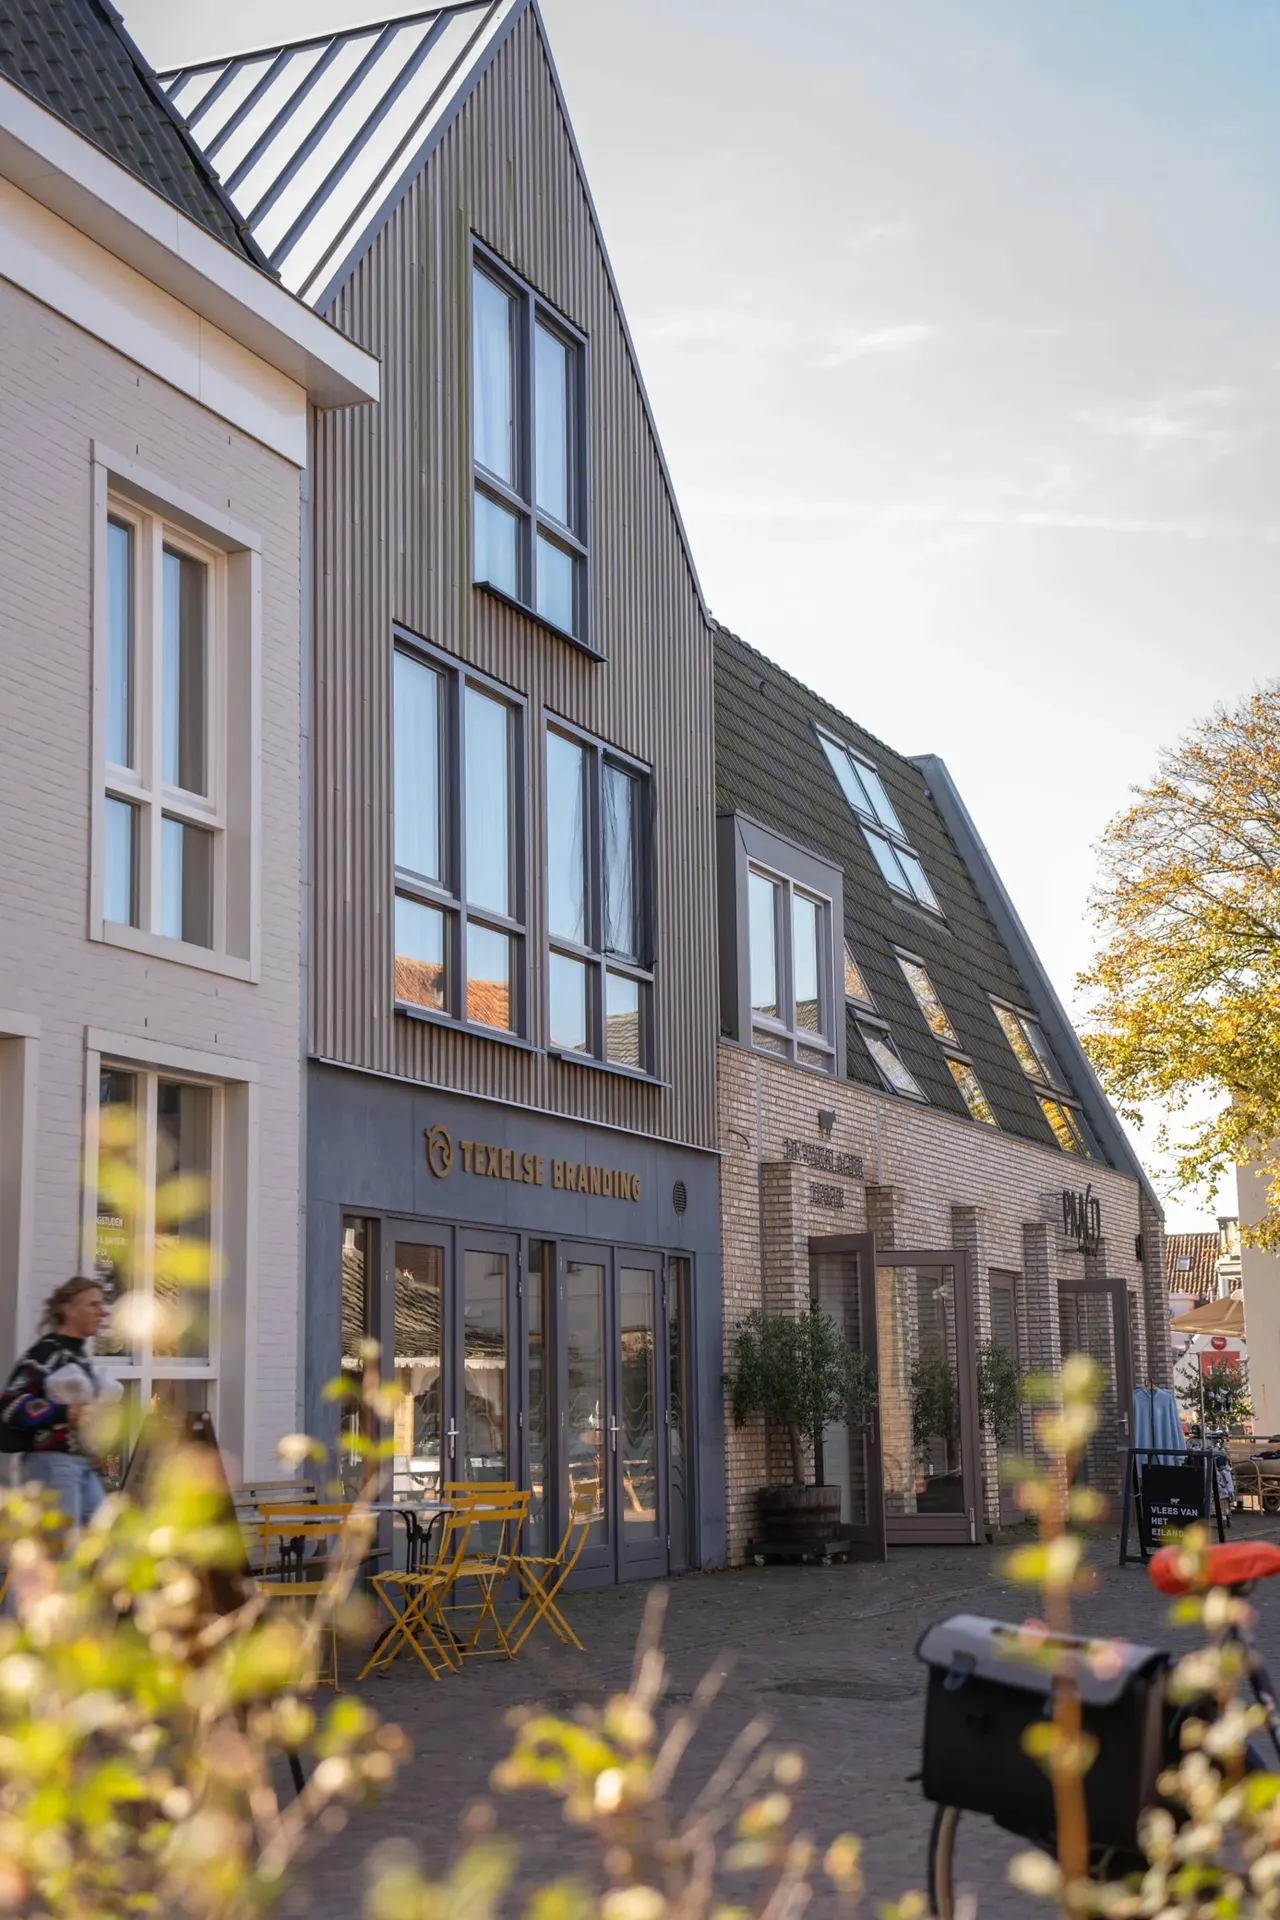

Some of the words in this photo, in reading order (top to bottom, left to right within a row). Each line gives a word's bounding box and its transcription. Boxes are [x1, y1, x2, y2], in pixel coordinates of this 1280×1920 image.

[459, 1140, 545, 1186] TEXELSE
[551, 1158, 642, 1202] BRANDING
[1150, 1506, 1179, 1515] VLEES
[1180, 1508, 1198, 1517] VAN
[1151, 1517, 1168, 1525] HET
